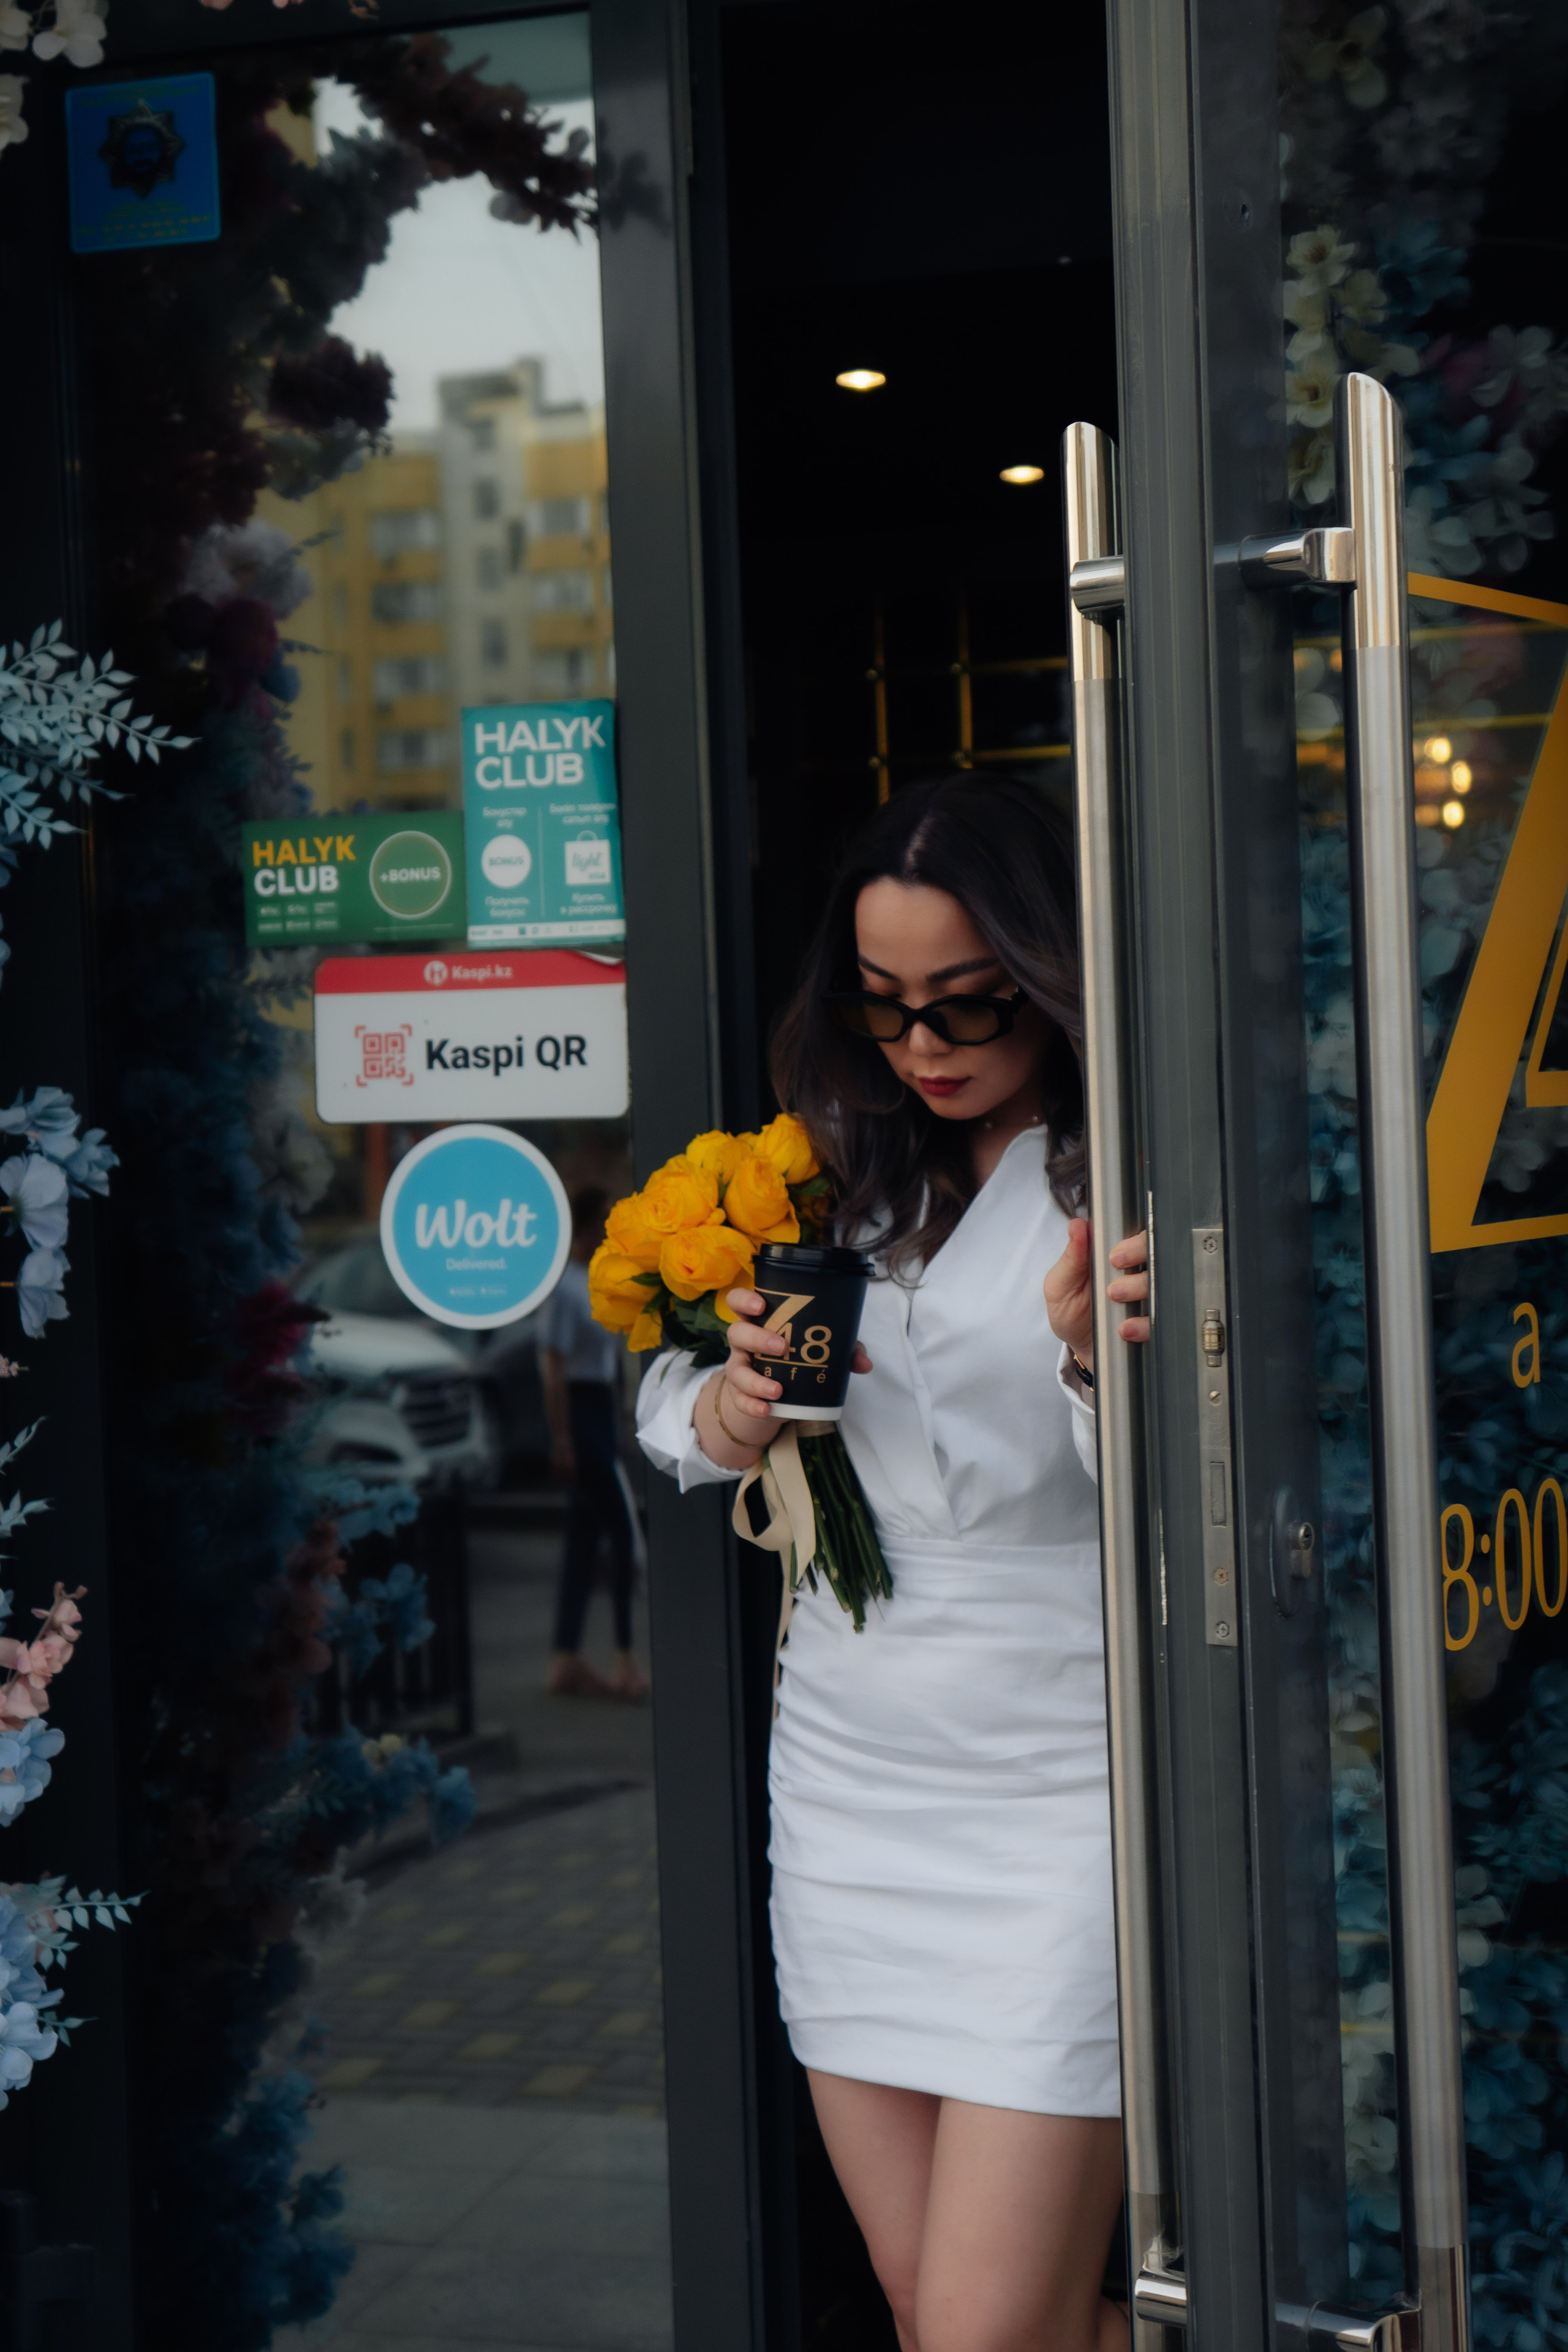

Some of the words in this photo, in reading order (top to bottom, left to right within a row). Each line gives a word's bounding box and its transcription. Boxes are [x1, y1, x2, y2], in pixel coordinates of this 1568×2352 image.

[475, 715, 606, 755] HALYK
[475, 752, 584, 790] CLUB
[252, 835, 356, 867] HALYK
[254, 865, 339, 897] CLUB
[452, 965, 512, 982] Kaspi.kz
[426, 1036, 524, 1076] Kaspi
[536, 1035, 586, 1071] QR
[415, 1198, 538, 1249] Wolt
